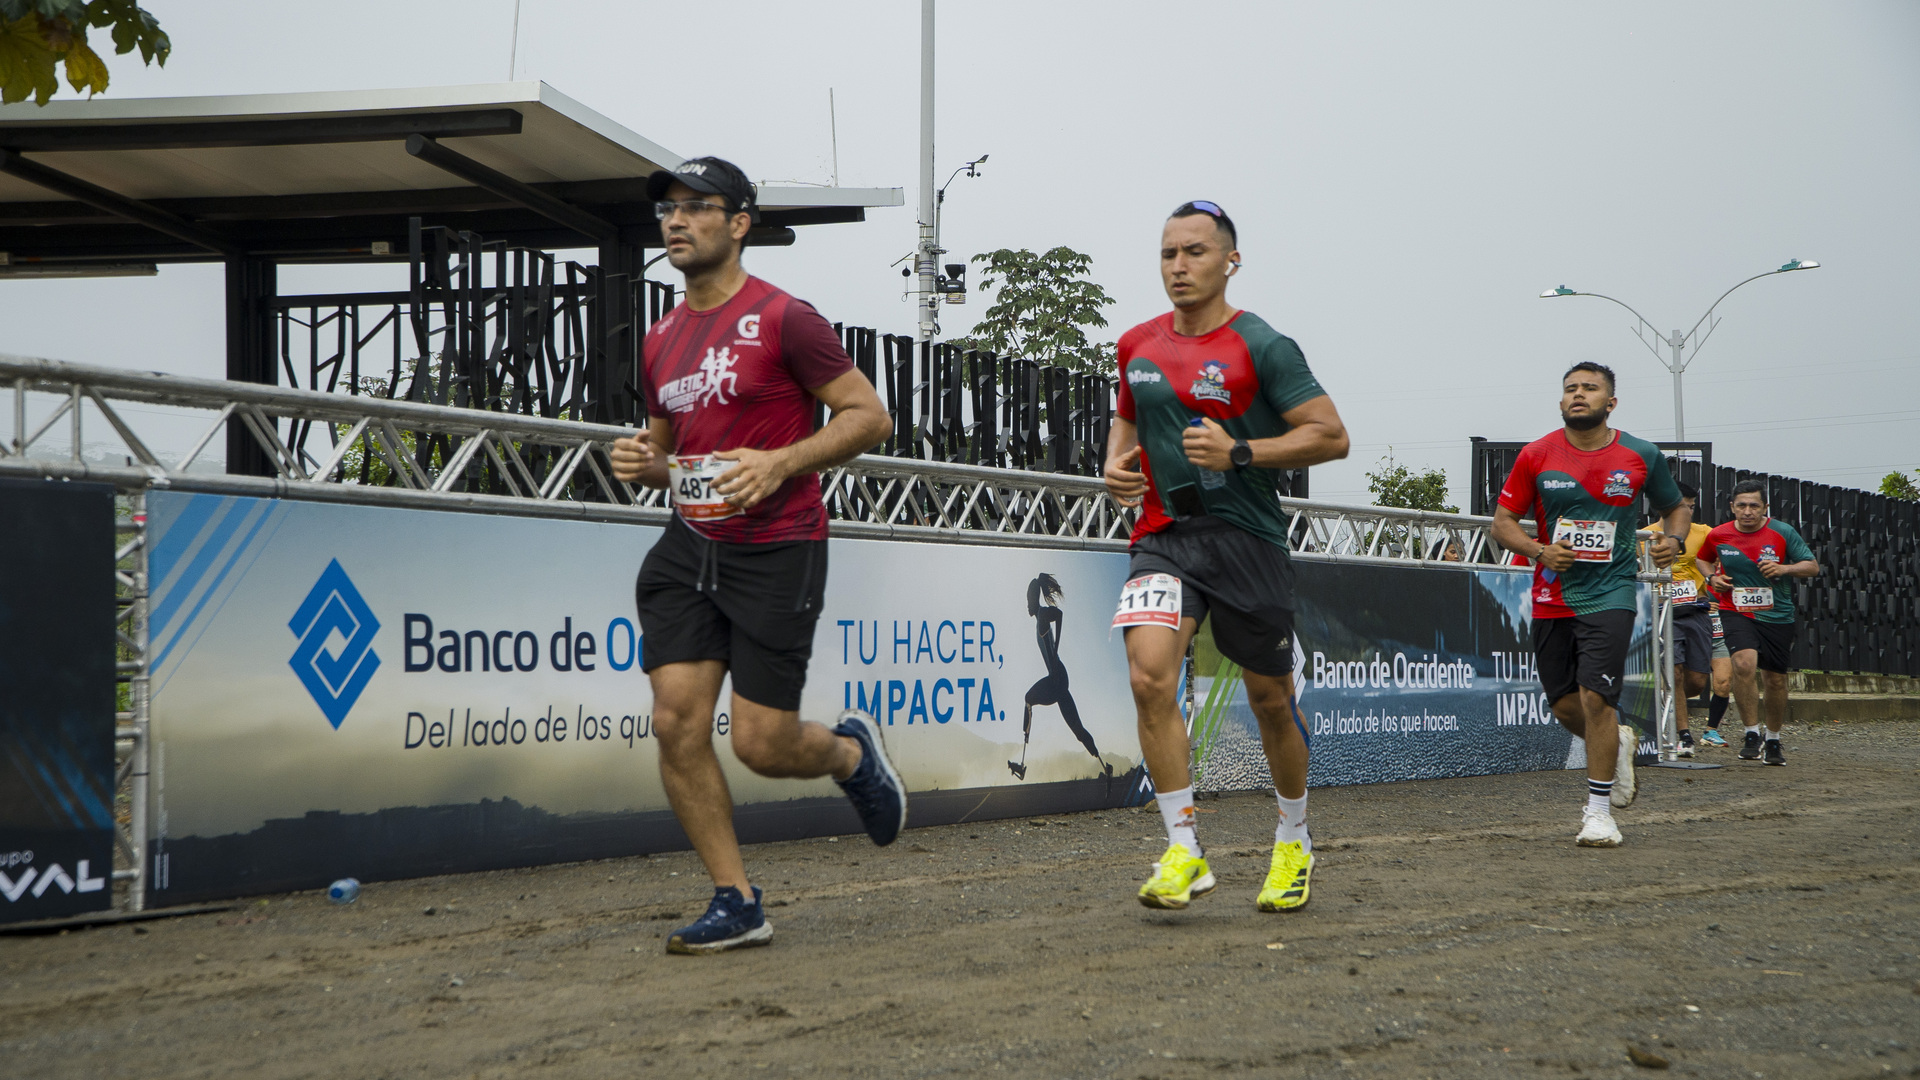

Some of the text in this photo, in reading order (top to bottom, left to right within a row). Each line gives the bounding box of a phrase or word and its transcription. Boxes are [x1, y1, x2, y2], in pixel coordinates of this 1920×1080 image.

[737, 314, 761, 339] G
[1741, 595, 1763, 604] 348
[404, 613, 539, 672] Banco
[550, 616, 597, 672] de
[837, 620, 1003, 669] TU HACER,
[1313, 651, 1472, 689] Banco de Occidente
[1492, 651, 1513, 683] TU
[845, 678, 1005, 726] IMPACTA.
[1496, 692, 1559, 726] IMPAC
[404, 708, 454, 749] Del
[463, 706, 527, 746] lado
[535, 704, 567, 742] de
[576, 704, 611, 741] los
[1314, 708, 1459, 738] Del lado de los que hacen.
[0, 850, 34, 868] upo
[0, 859, 105, 902] VAL
